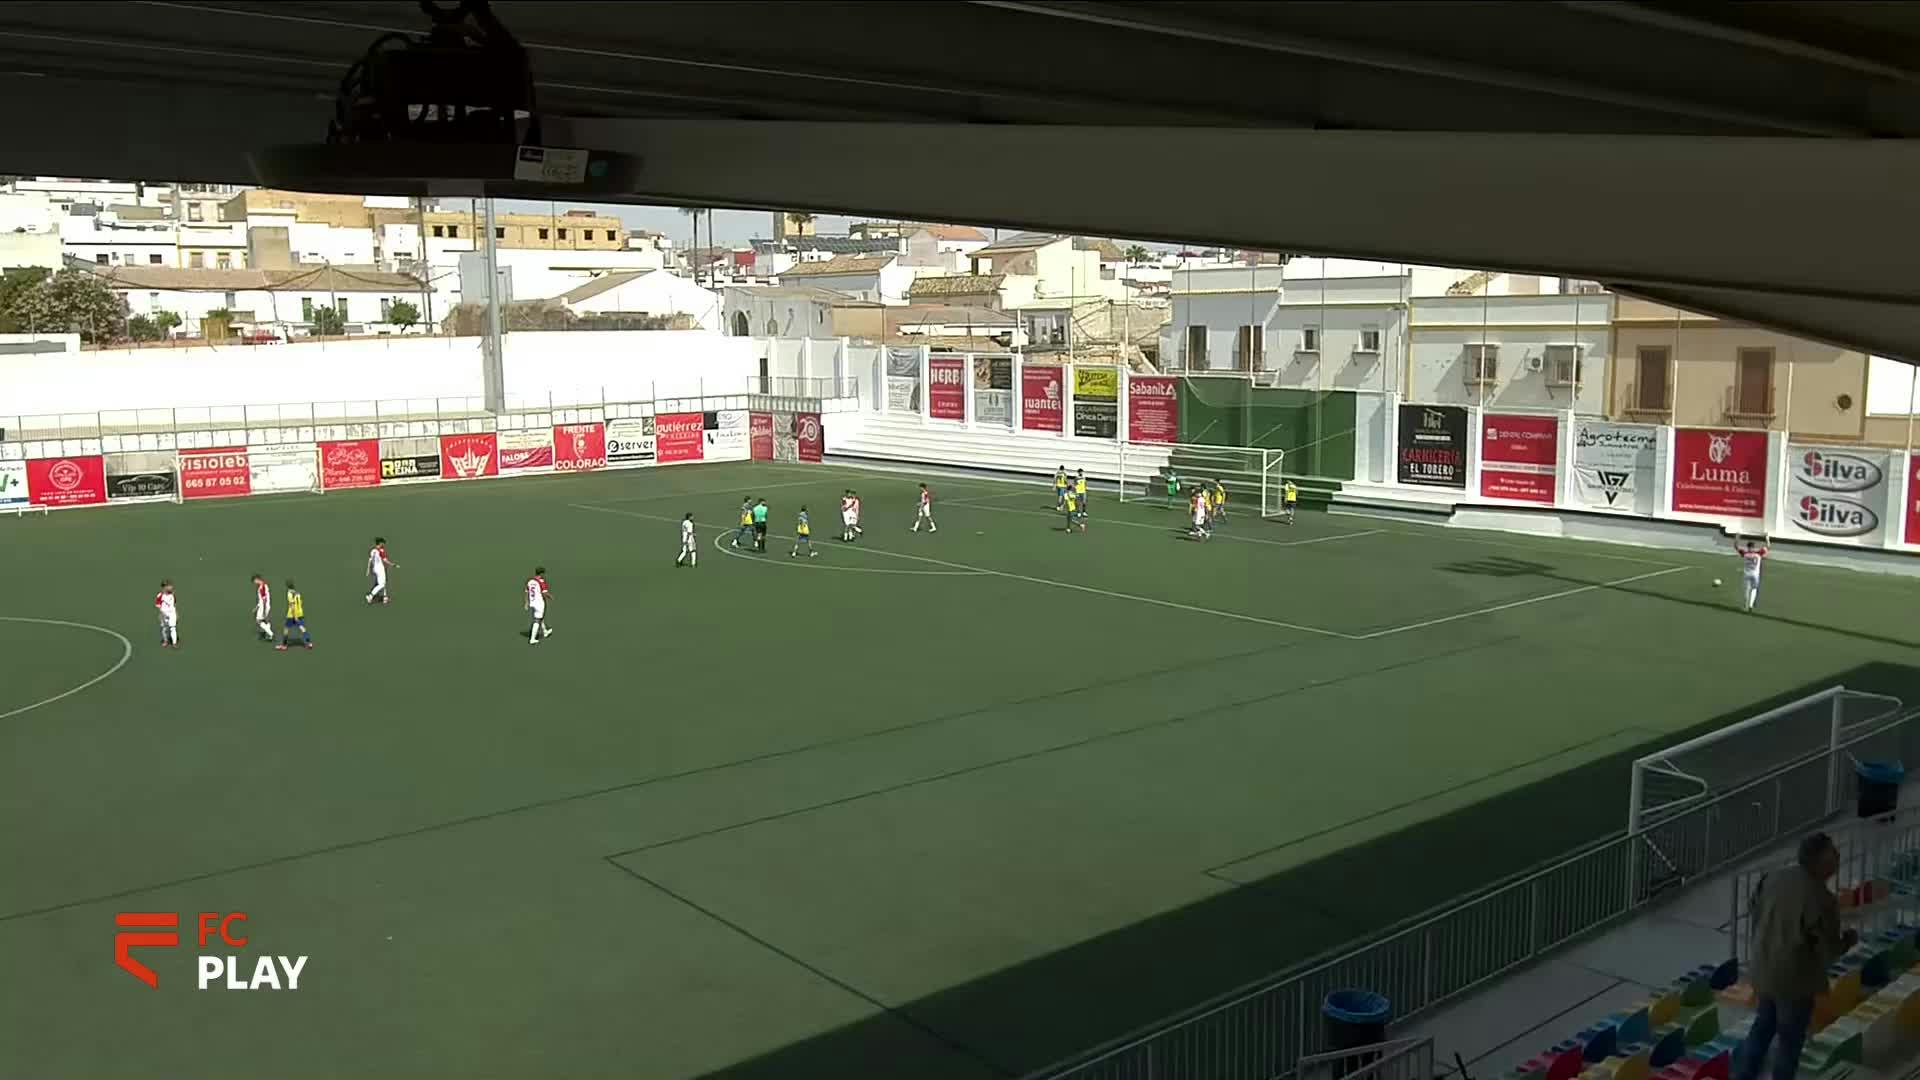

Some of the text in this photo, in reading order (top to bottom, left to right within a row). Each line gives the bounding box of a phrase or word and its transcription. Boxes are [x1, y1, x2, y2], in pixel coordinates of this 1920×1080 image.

[563, 424, 595, 434] FRENTE
[555, 457, 607, 470] COLORAO
[1410, 463, 1454, 476] EL TORERO
[1690, 460, 1751, 484] Luma
[1803, 451, 1866, 480] Silva
[1800, 495, 1863, 525] Silva
